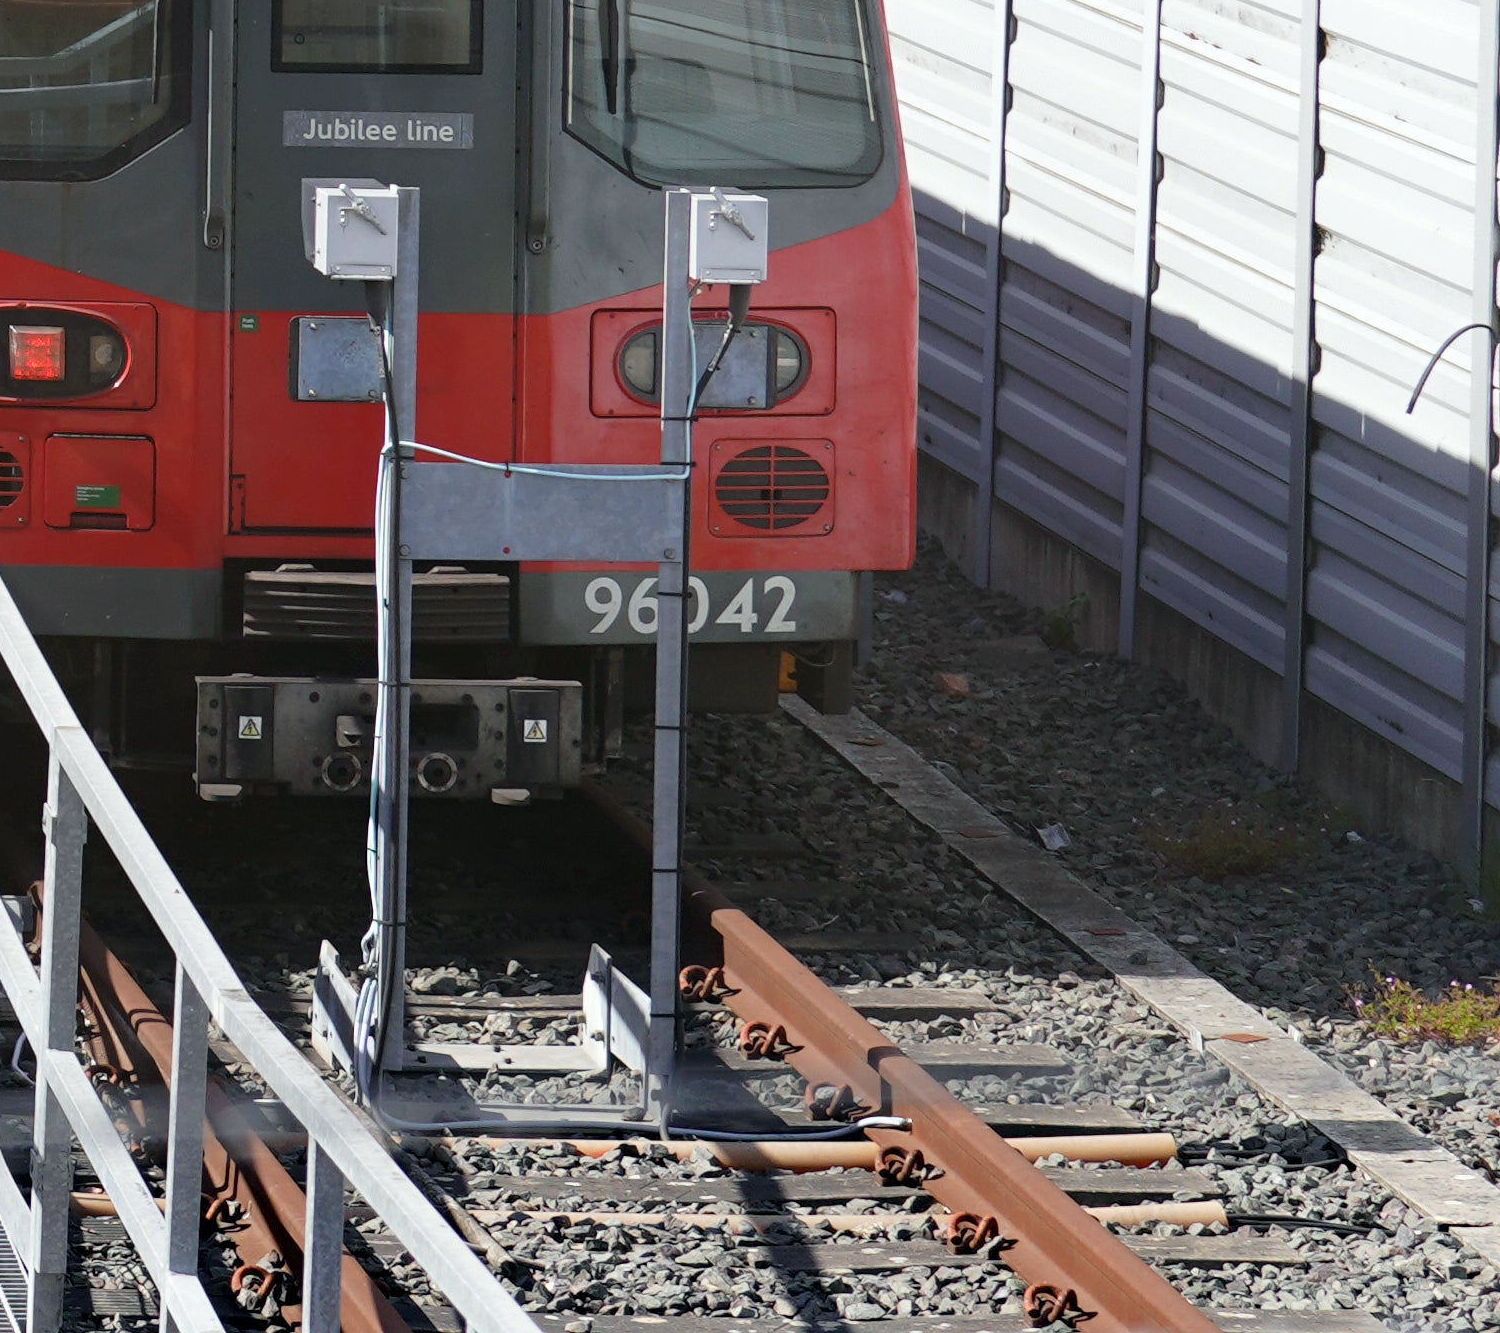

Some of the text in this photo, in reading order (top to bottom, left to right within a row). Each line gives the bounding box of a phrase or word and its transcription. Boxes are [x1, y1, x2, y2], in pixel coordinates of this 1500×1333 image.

[302, 118, 455, 142] Jubilee line
[584, 575, 798, 635] 96042
